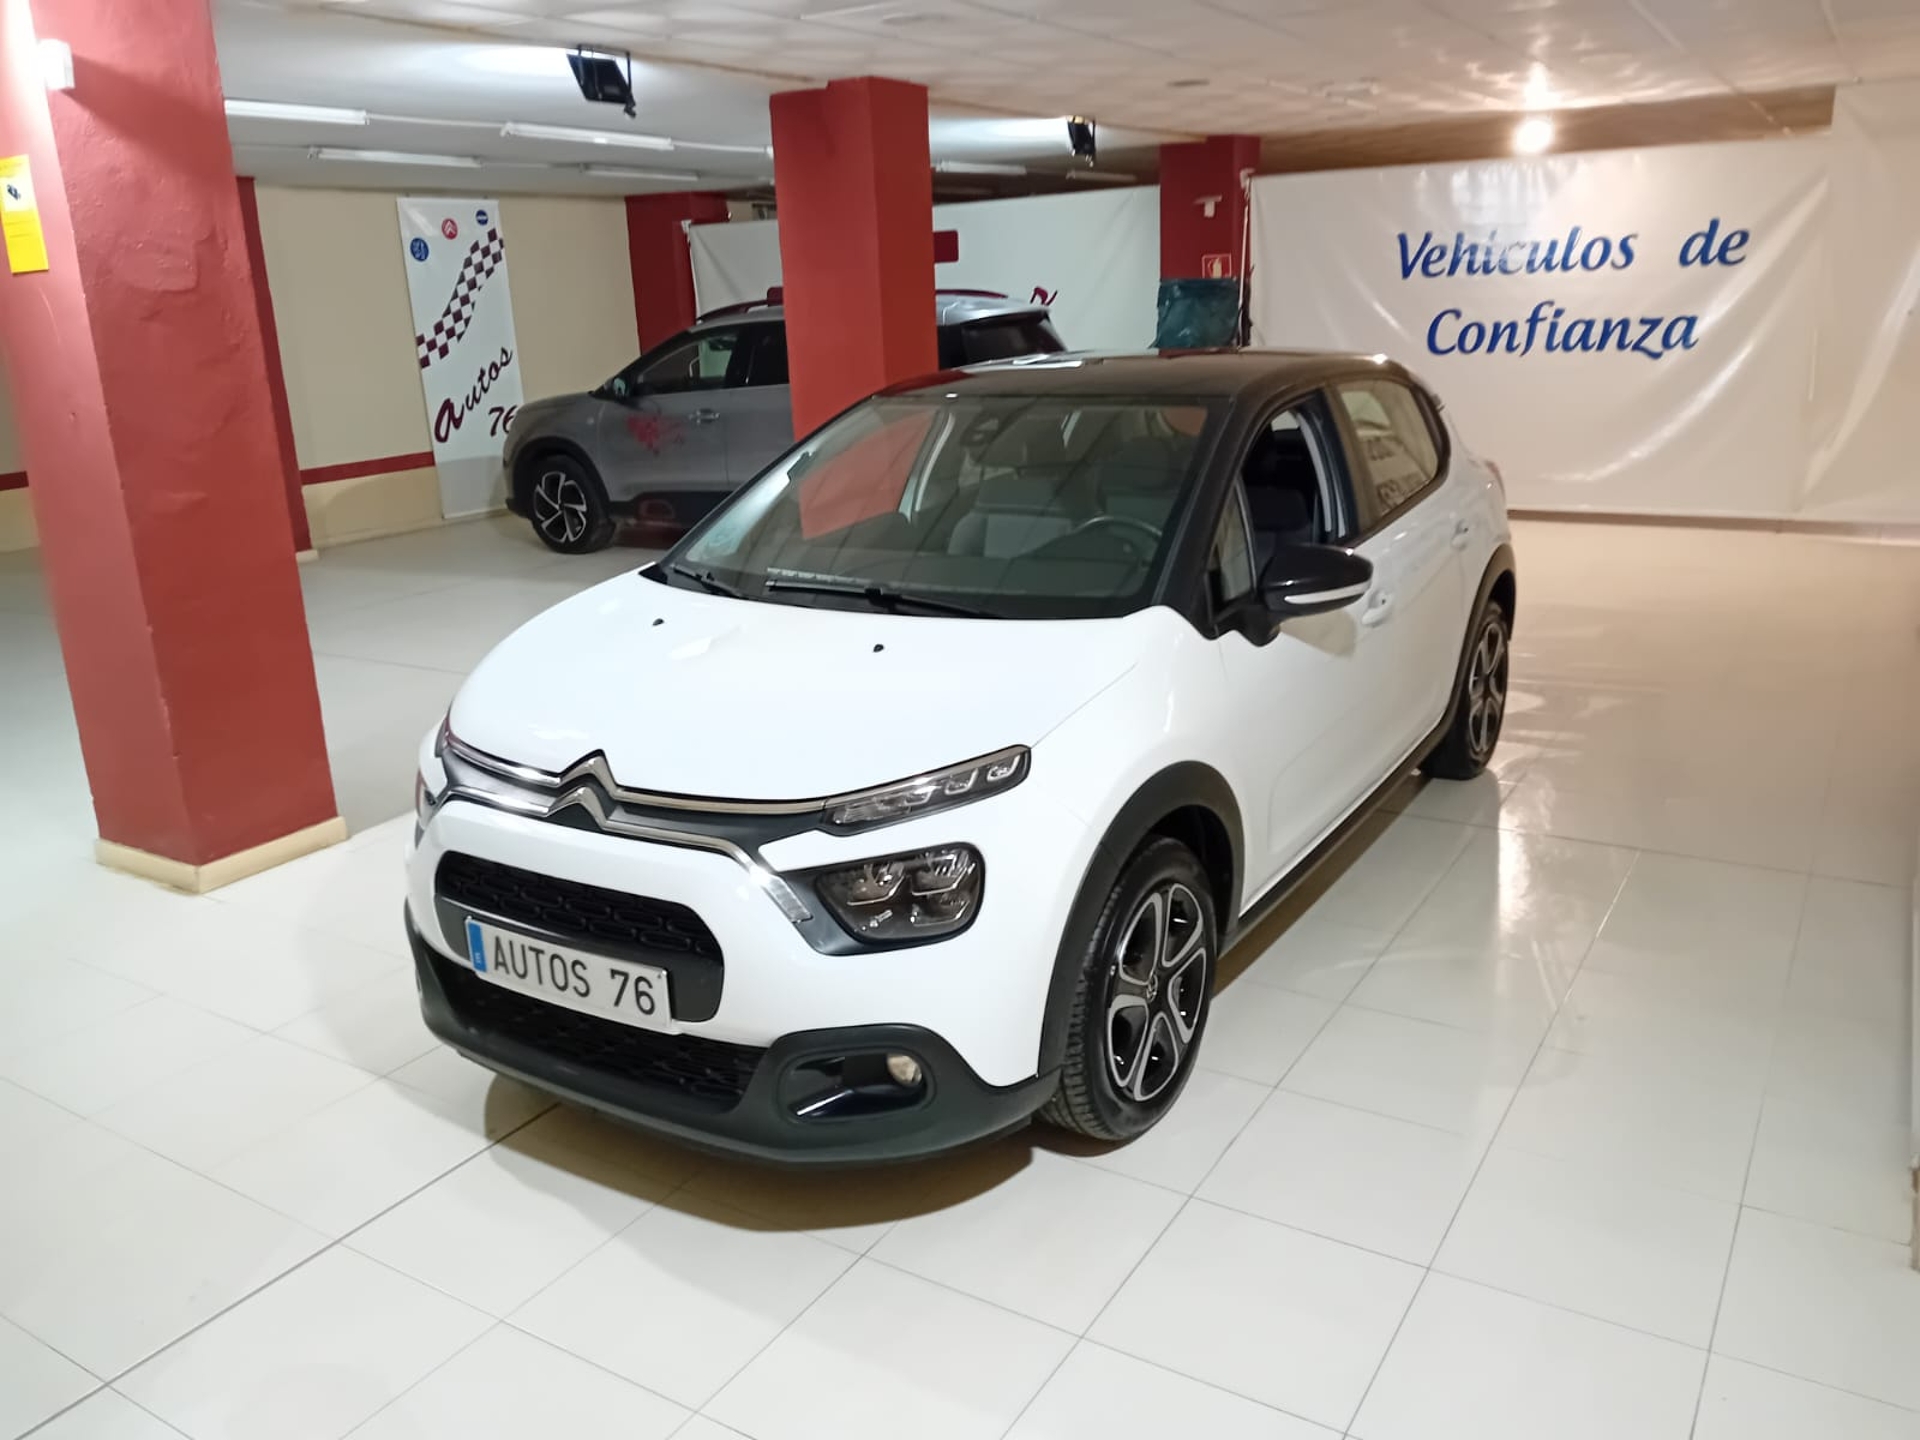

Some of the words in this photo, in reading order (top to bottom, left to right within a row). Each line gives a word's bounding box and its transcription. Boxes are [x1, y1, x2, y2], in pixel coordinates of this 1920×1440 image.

[1398, 226, 1639, 279] Vehículos
[1679, 218, 1750, 267] de
[1427, 300, 1699, 359] Confianza
[494, 936, 591, 998] AUTOS
[610, 968, 655, 1016] 76
